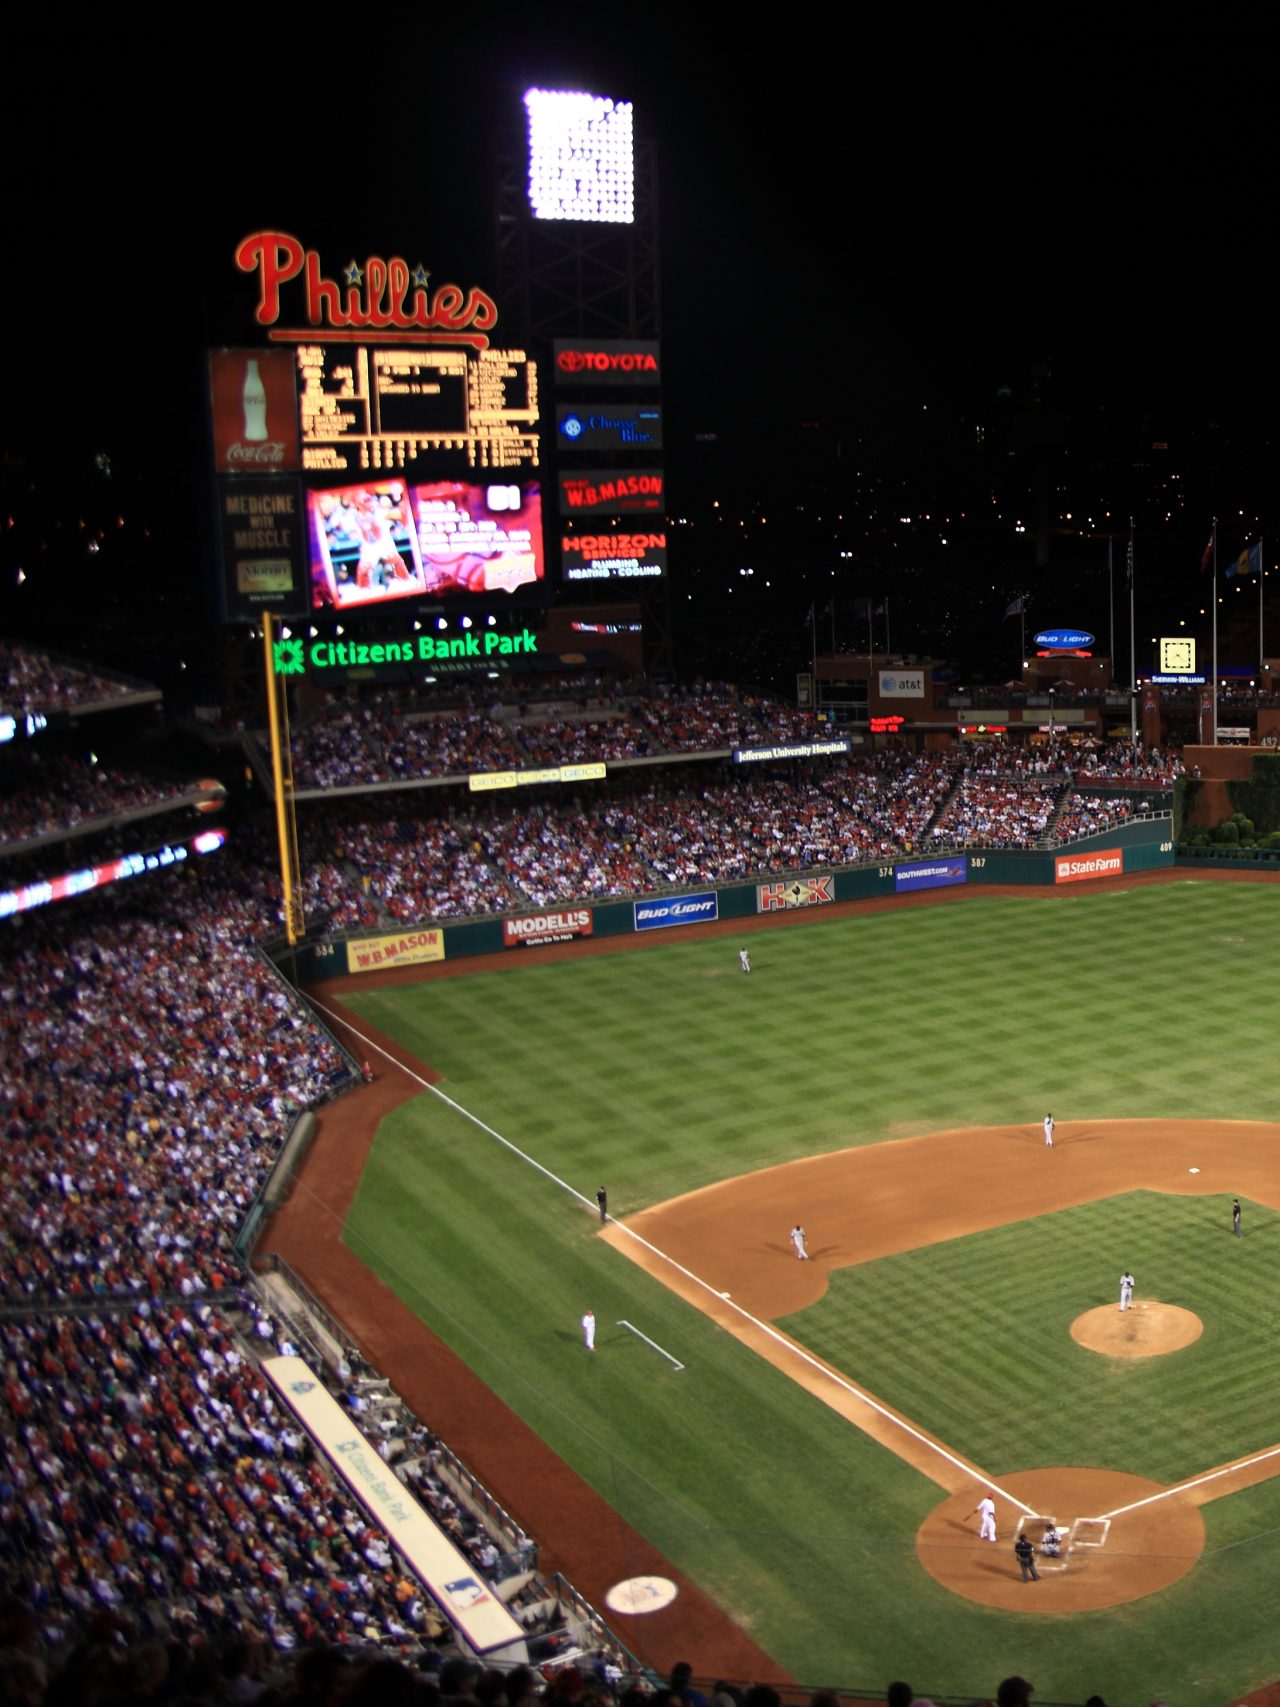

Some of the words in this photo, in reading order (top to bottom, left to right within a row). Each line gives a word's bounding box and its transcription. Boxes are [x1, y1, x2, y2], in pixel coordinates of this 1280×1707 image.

[236, 231, 498, 330] Phillies
[585, 352, 658, 371] TOYOTA
[589, 415, 637, 431] Choose
[227, 443, 286, 462] Coca-Cola
[599, 476, 662, 500] MASON
[225, 495, 295, 515] MEDICINE
[234, 530, 292, 549] MUSCLE
[562, 534, 666, 551] HORIZON
[583, 548, 645, 559] SERVICES
[618, 566, 662, 576] COOLING
[311, 641, 414, 666] Citizens
[419, 632, 480, 660] Bank
[485, 628, 538, 655] Park
[1037, 635, 1058, 643] BUD
[1063, 635, 1092, 643] LIGHT
[899, 679, 922, 690] at&t
[739, 750, 772, 762] Jefferson
[773, 745, 811, 757] University
[812, 741, 847, 754] Hospitals
[1160, 842, 1173, 853] 409
[897, 867, 948, 880] SOUTHWEST.COM
[637, 908, 669, 920] BUD
[675, 901, 715, 914] LIGHT
[507, 911, 590, 936] MODELL'S
[384, 931, 439, 958] MASON
[371, 1481, 395, 1503] Bank
[389, 1502, 412, 1522] Park
